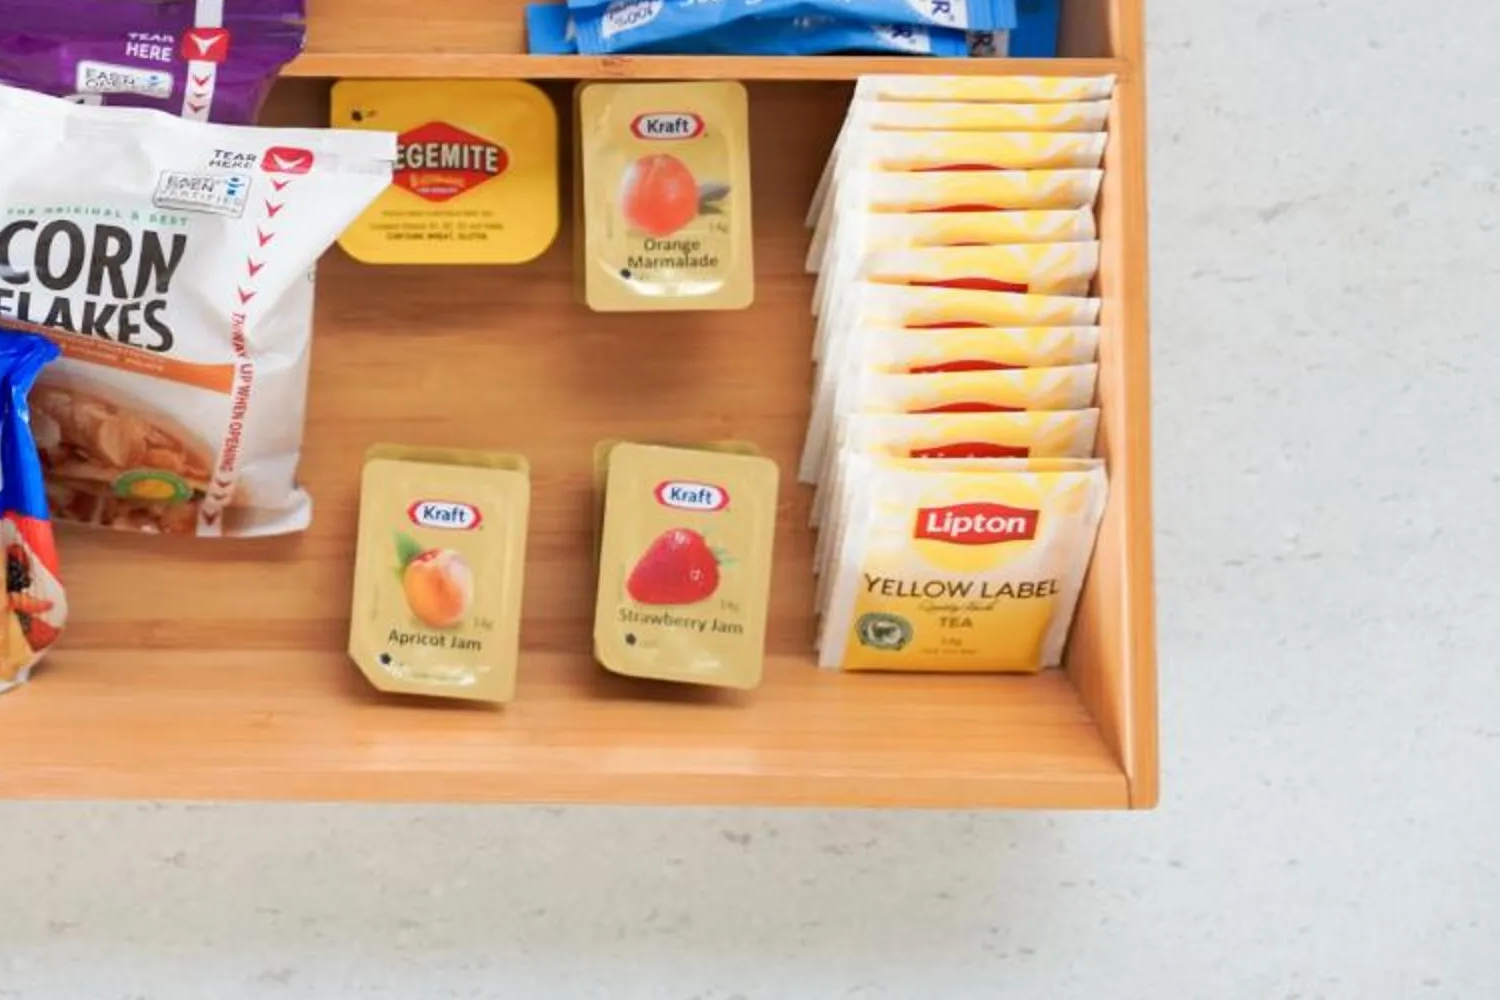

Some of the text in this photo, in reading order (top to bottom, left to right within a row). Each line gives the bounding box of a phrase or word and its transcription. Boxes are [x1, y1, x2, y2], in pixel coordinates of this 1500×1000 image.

[126, 42, 173, 62] HERE
[646, 117, 690, 136] Kraft
[393, 142, 499, 173] EGEMITE
[643, 238, 701, 256] Orange
[627, 252, 718, 269] Marmalade
[670, 486, 714, 505] Kraft
[422, 505, 466, 524] Kraft
[925, 511, 1027, 537] Lipton
[864, 572, 1061, 599] YELLOW LABEL
[617, 607, 744, 635] Strawberry Jam
[938, 616, 973, 629] TEA
[389, 629, 482, 651] Apricot Jam
